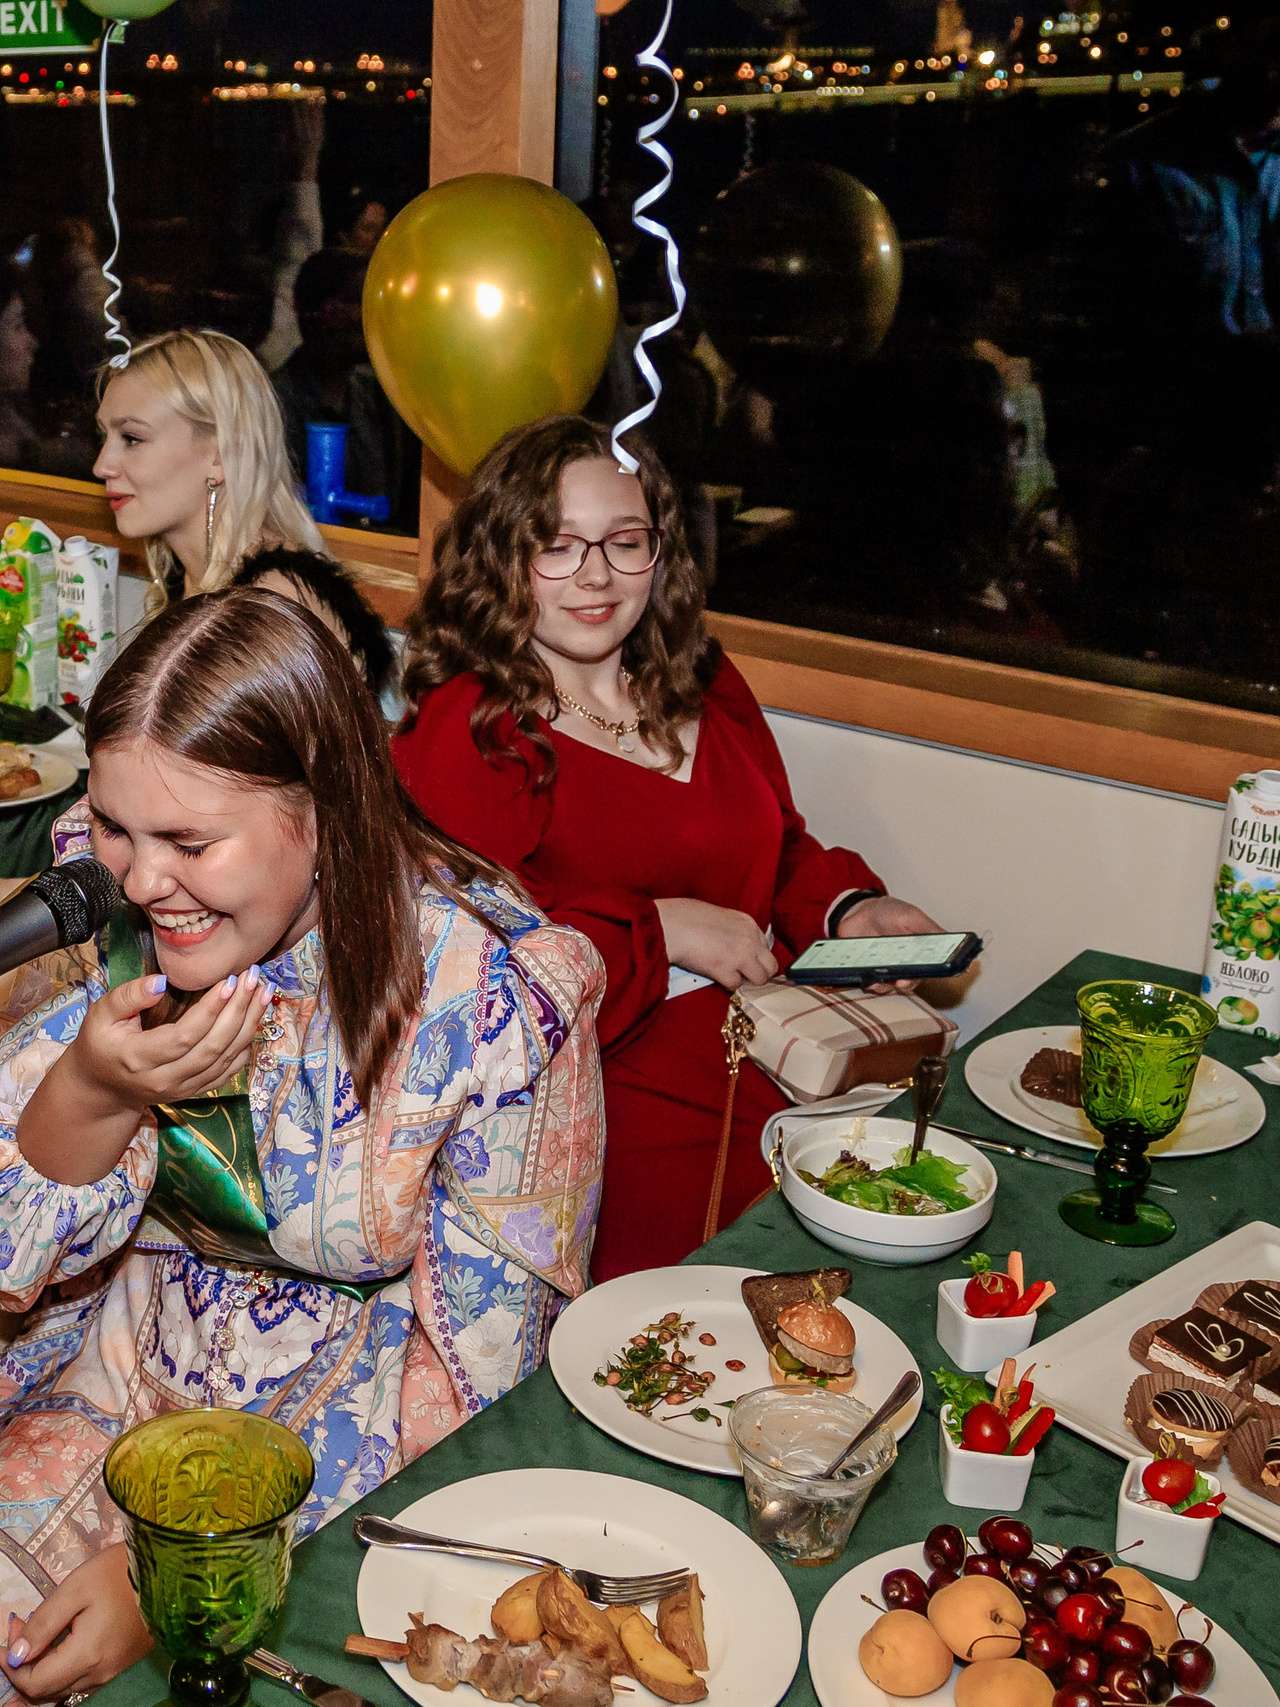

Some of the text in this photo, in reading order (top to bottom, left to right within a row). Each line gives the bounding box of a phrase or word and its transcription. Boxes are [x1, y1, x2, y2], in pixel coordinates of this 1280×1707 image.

[0, 0, 66, 35] EXIT
[1231, 817, 1278, 844] САДЫ
[1220, 962, 1270, 984] ЯБЛОКО
